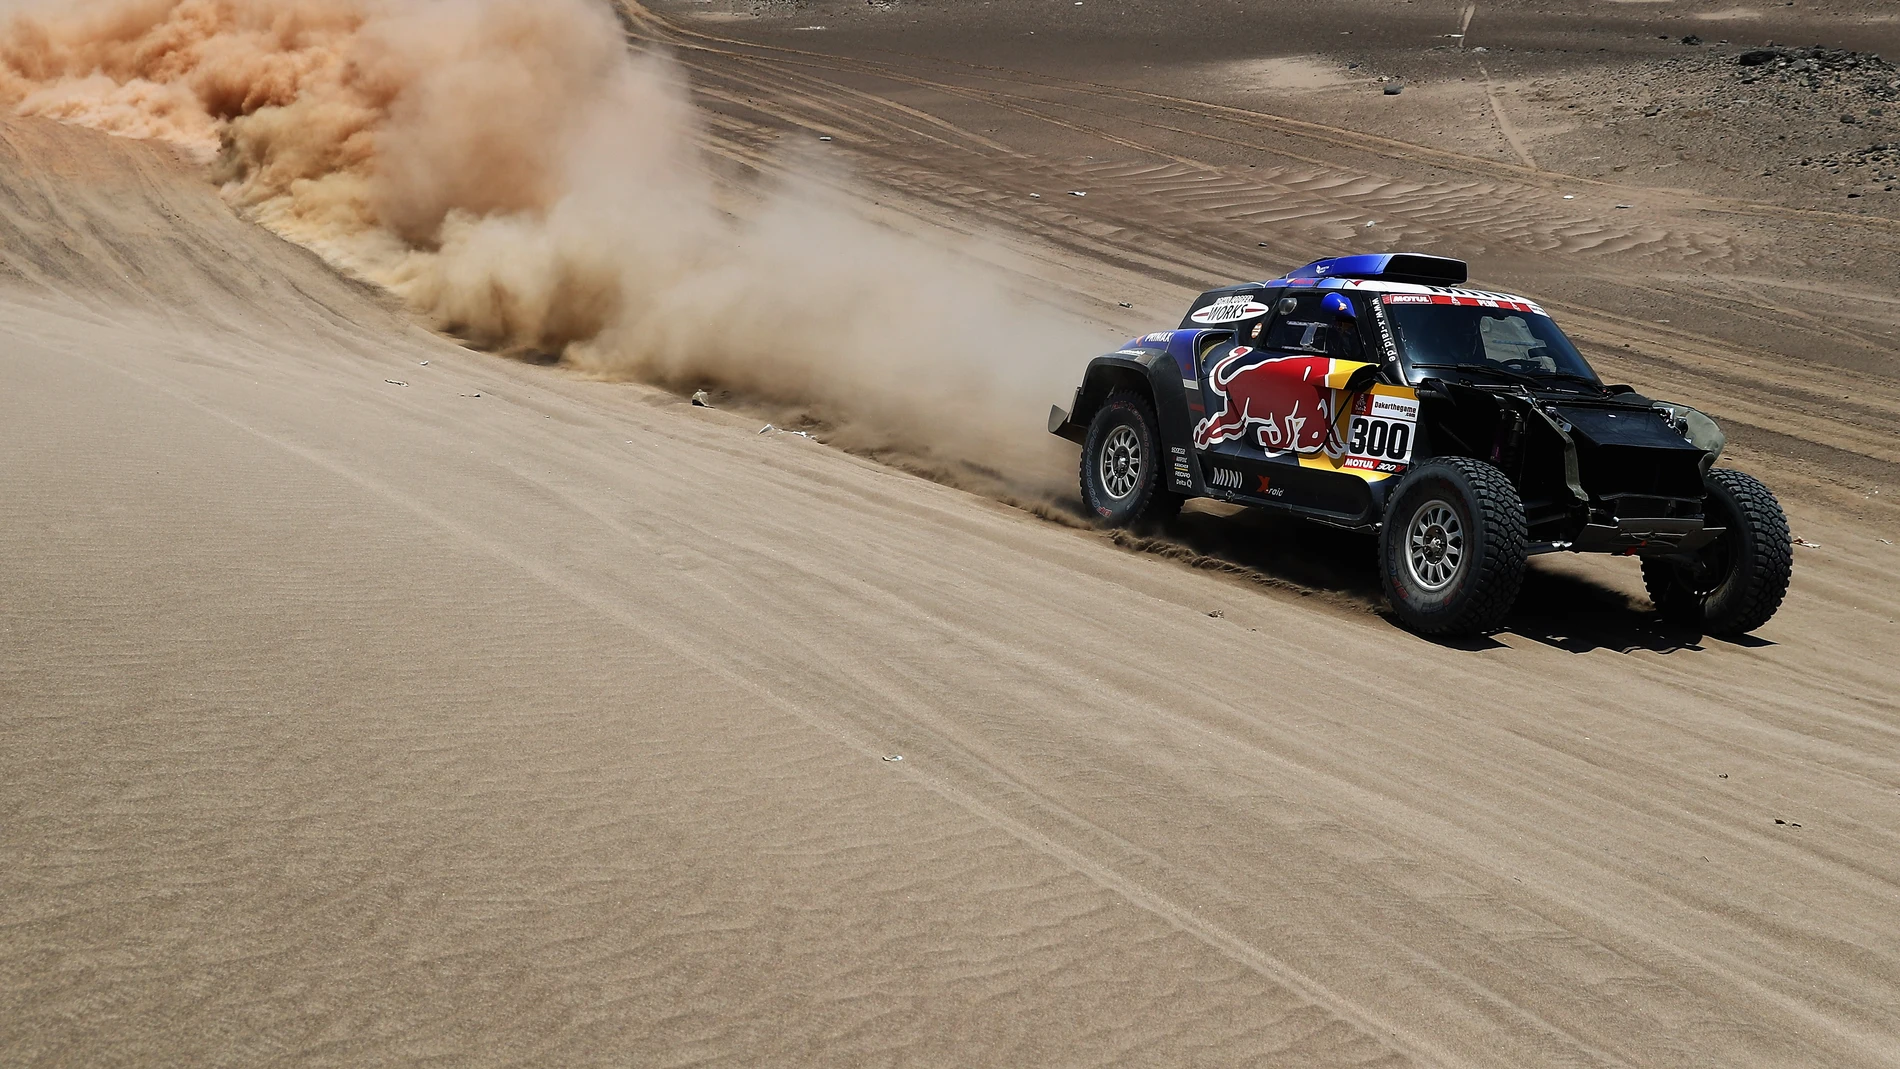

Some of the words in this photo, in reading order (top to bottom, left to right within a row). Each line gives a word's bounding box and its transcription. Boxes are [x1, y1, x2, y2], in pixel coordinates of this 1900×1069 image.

[1207, 304, 1249, 321] WORKS
[1372, 297, 1397, 362] www.x-raid.de
[1374, 401, 1417, 413] Dakarthegame
[1349, 417, 1410, 460] 300
[1345, 458, 1374, 469] MOTUL
[1212, 467, 1243, 489] MINI
